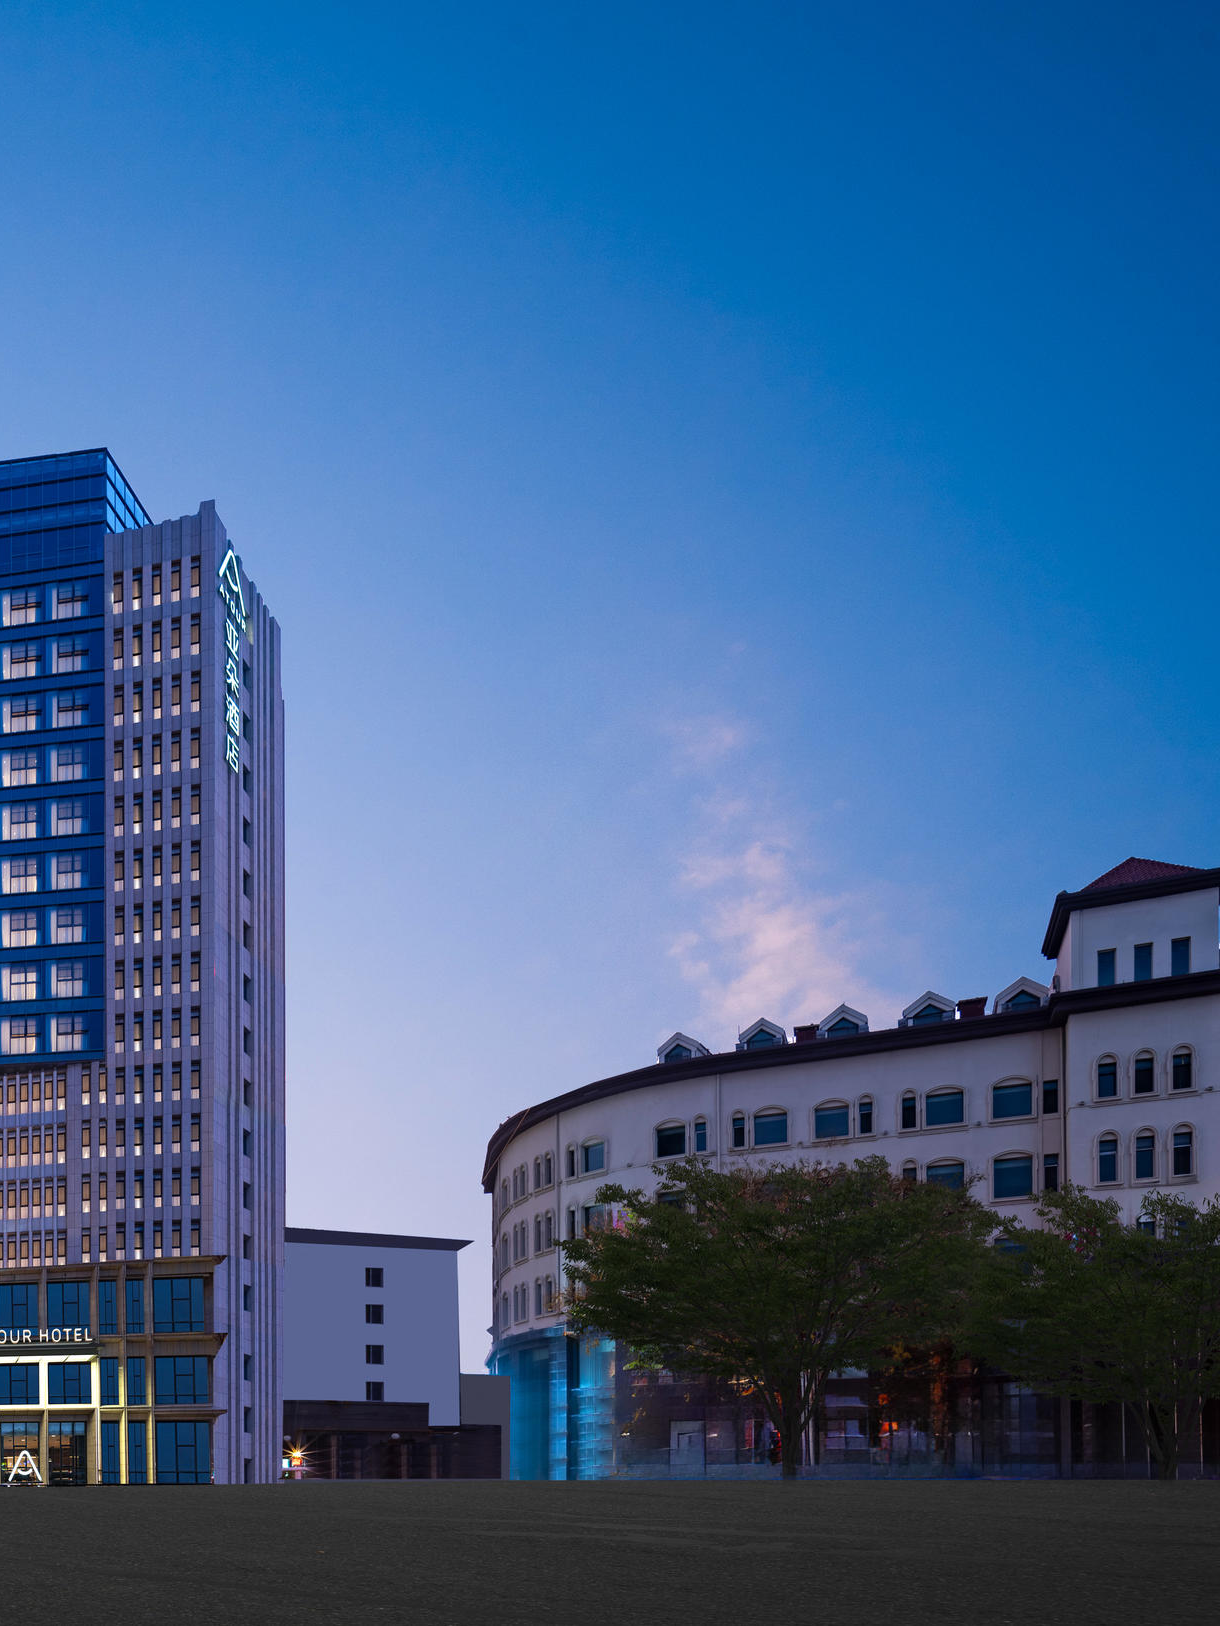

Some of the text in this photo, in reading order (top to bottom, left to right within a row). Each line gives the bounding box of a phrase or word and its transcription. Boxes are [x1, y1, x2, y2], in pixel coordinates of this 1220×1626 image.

[219, 583, 246, 632] ATOUR
[225, 617, 240, 773] 亚朵酒店
[39, 1328, 93, 1343] HOTEL
